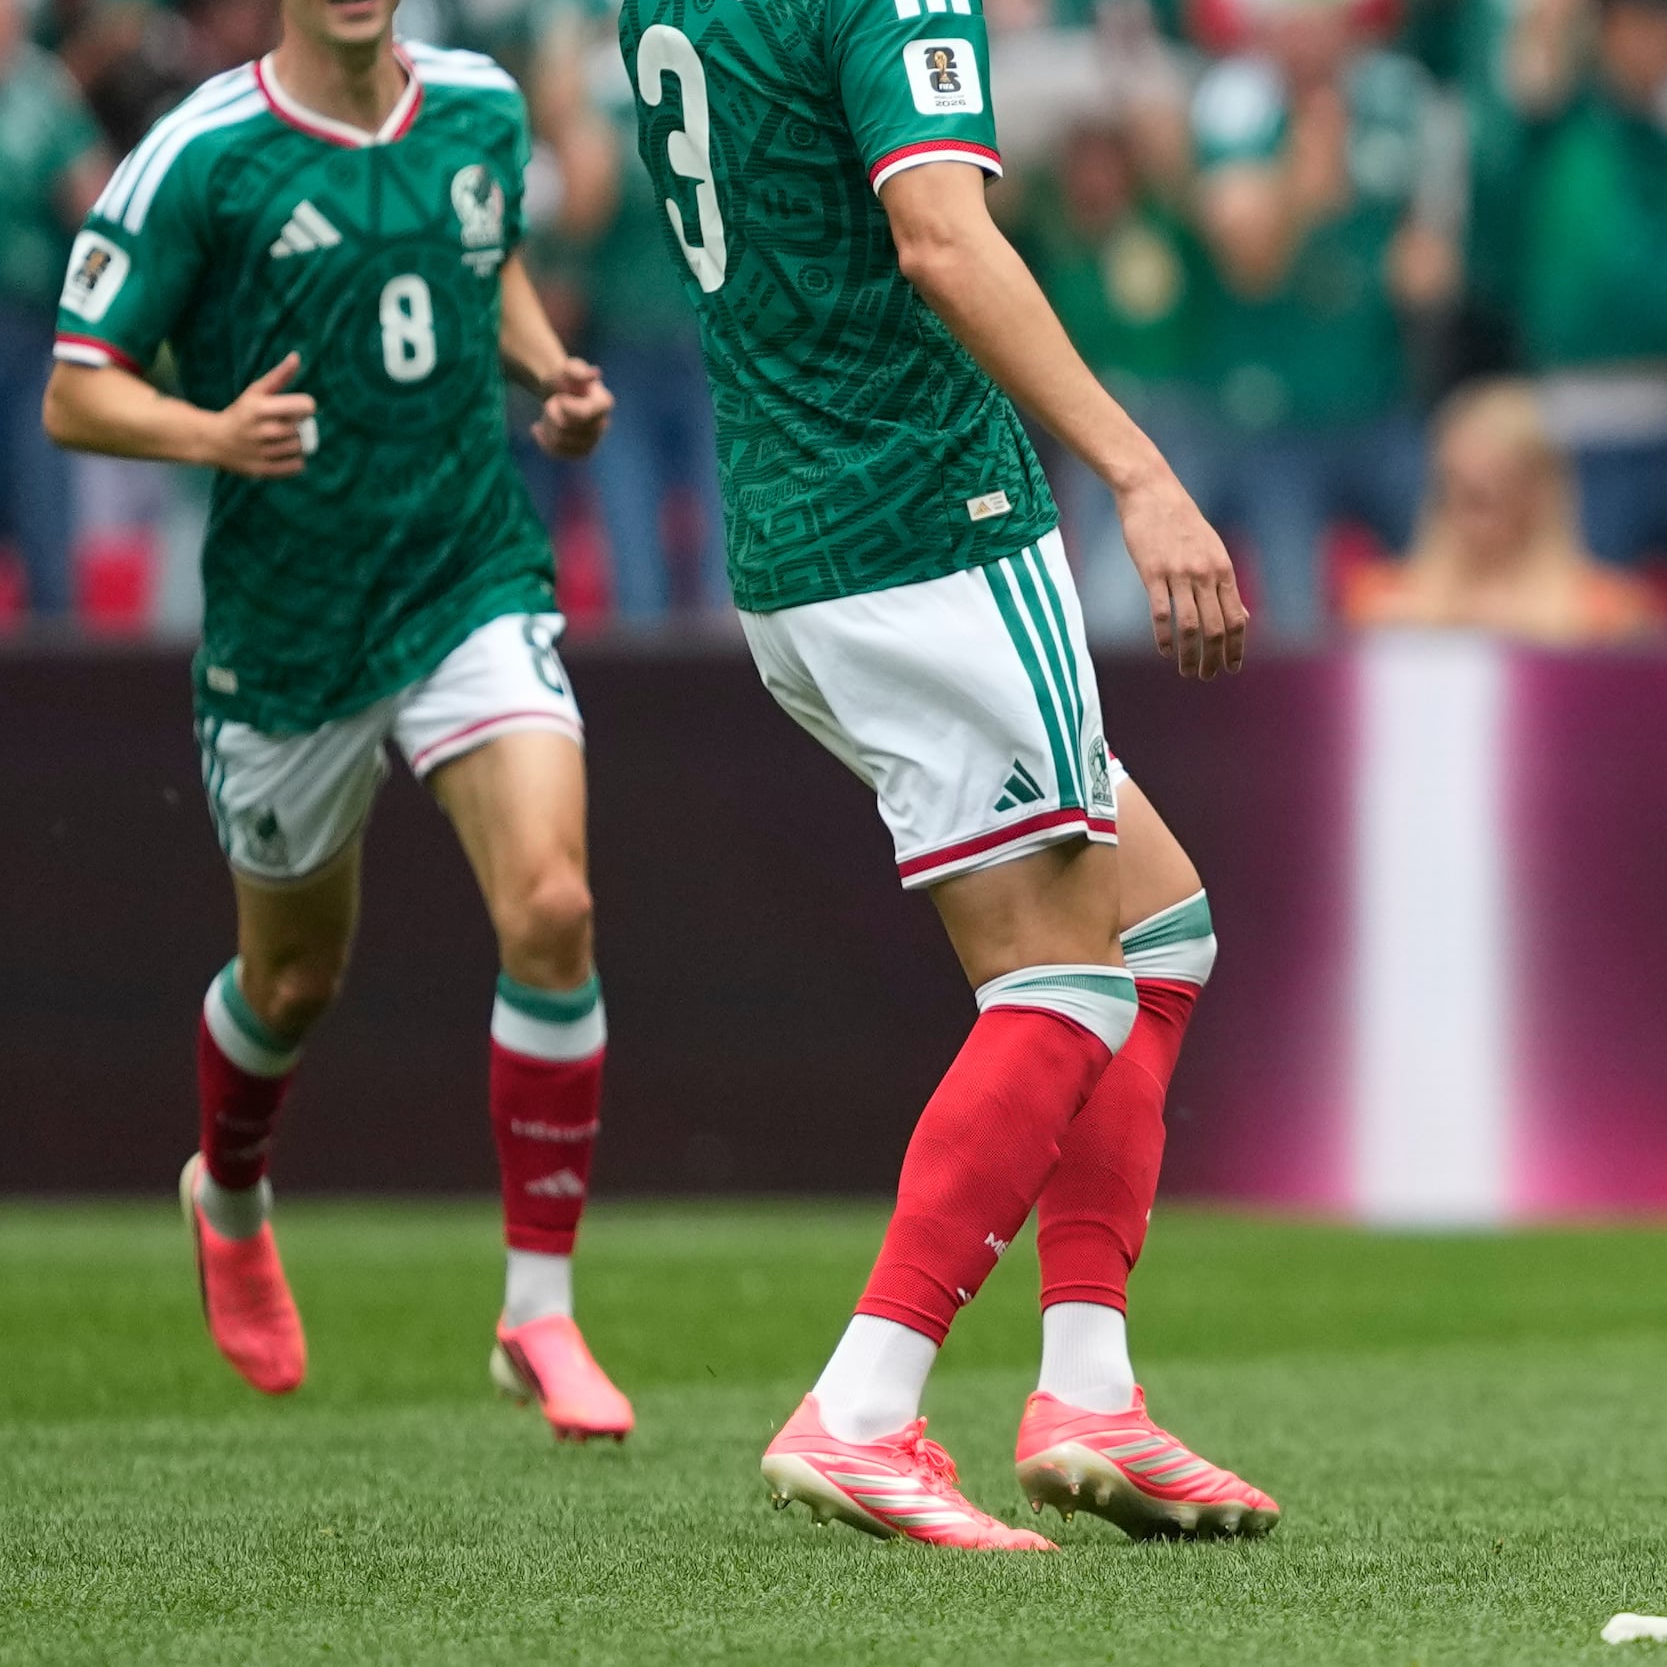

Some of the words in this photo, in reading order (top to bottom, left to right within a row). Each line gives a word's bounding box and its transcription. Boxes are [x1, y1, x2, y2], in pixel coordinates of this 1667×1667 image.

[637, 24, 728, 294] 3
[935, 99, 967, 107] 2026
[379, 272, 438, 384] 8
